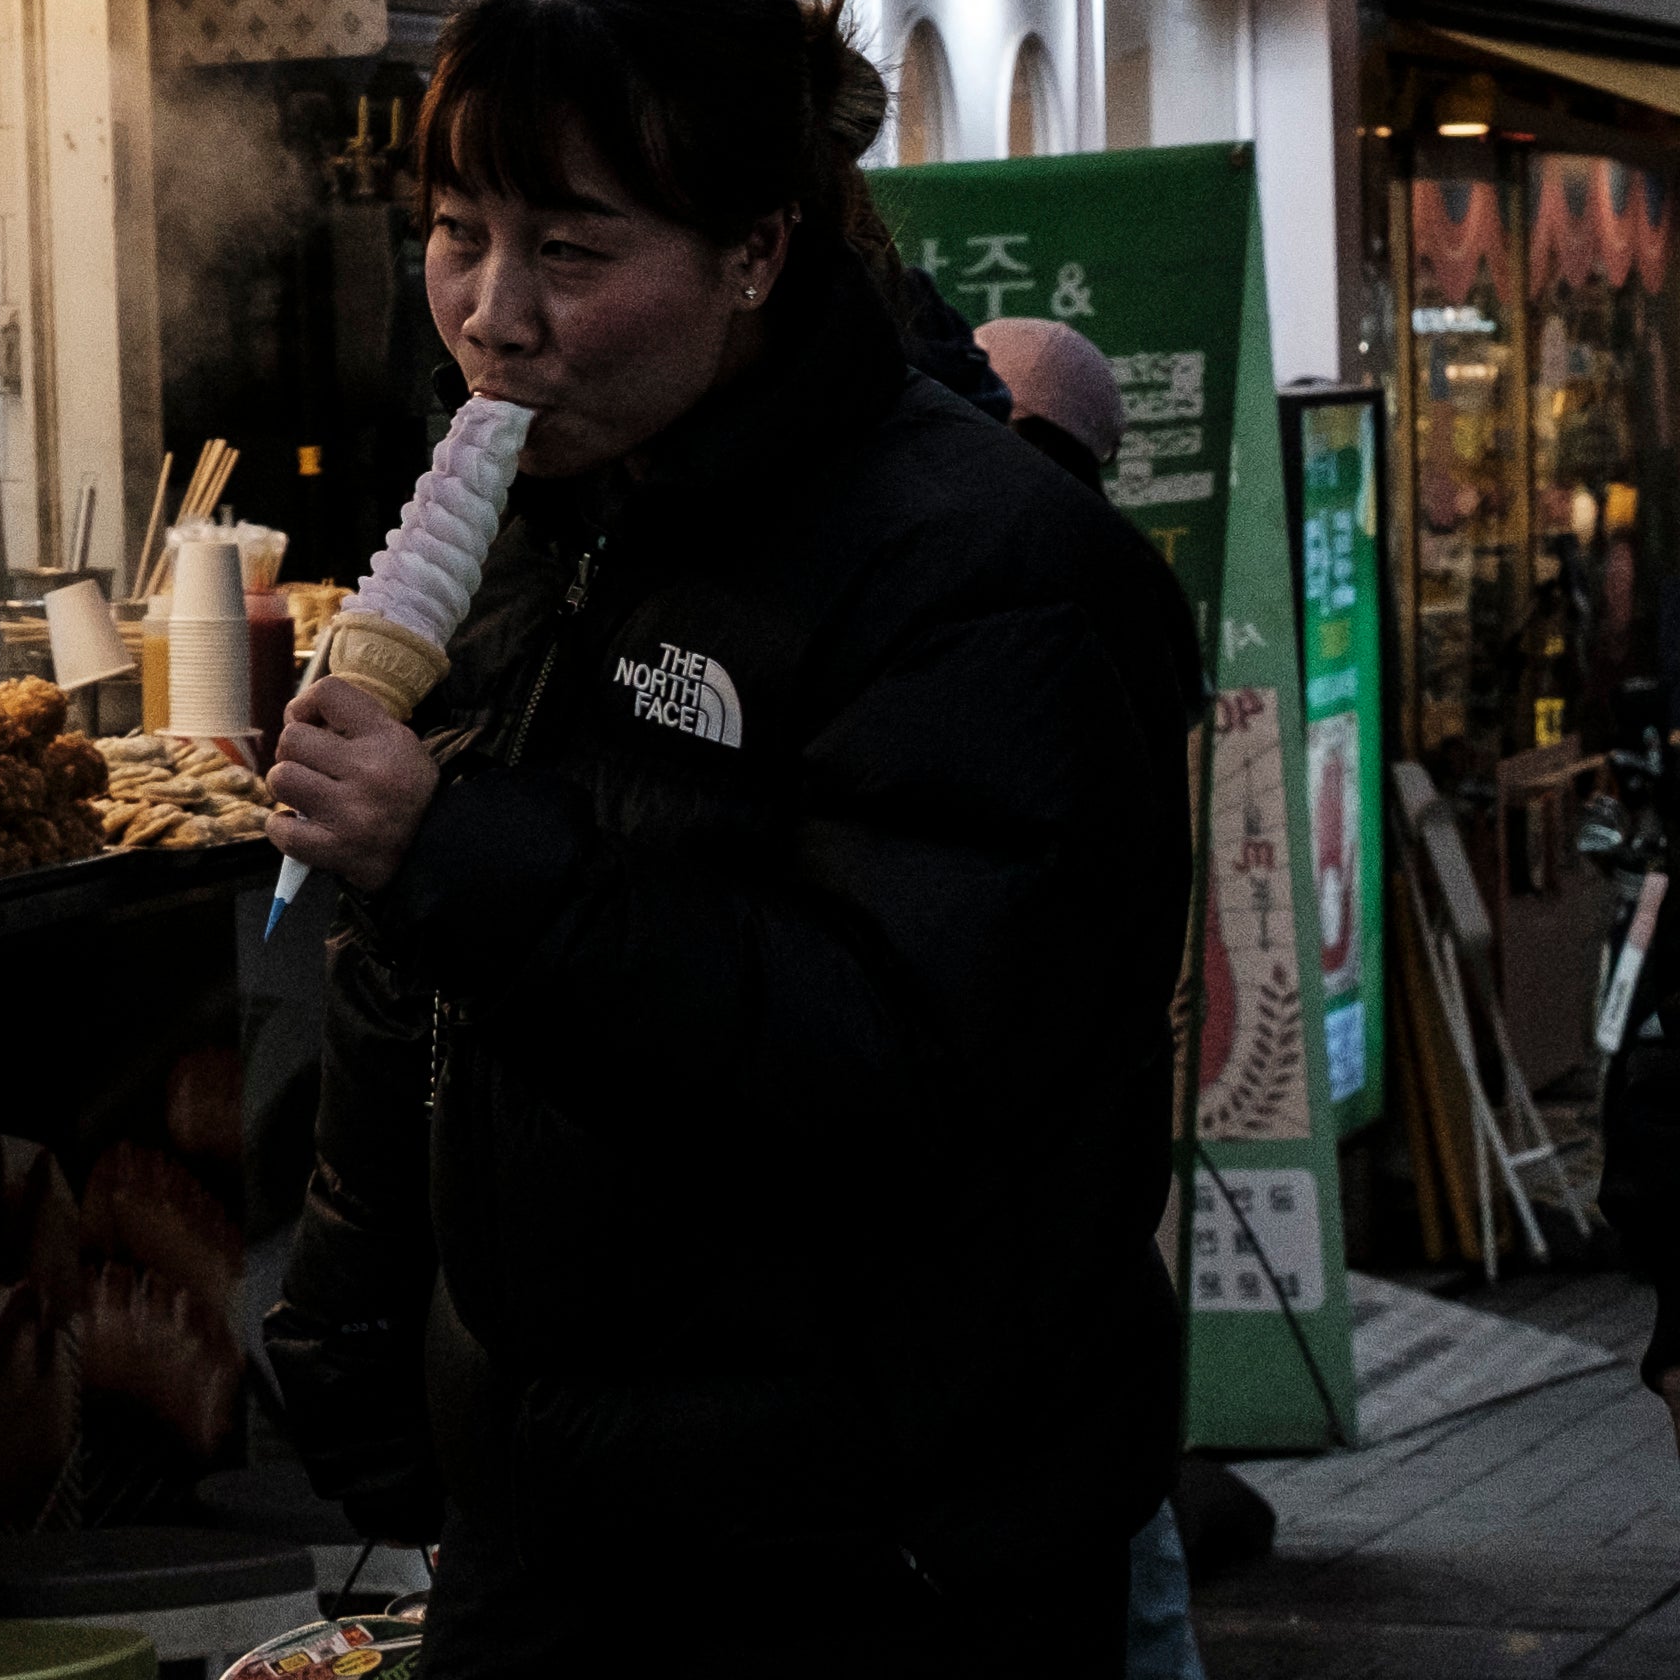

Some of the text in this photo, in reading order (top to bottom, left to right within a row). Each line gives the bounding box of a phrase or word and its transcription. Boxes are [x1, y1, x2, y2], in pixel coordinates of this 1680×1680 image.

[612, 656, 700, 708] NORTH
[659, 642, 707, 681] THE
[634, 690, 694, 734] FACE
